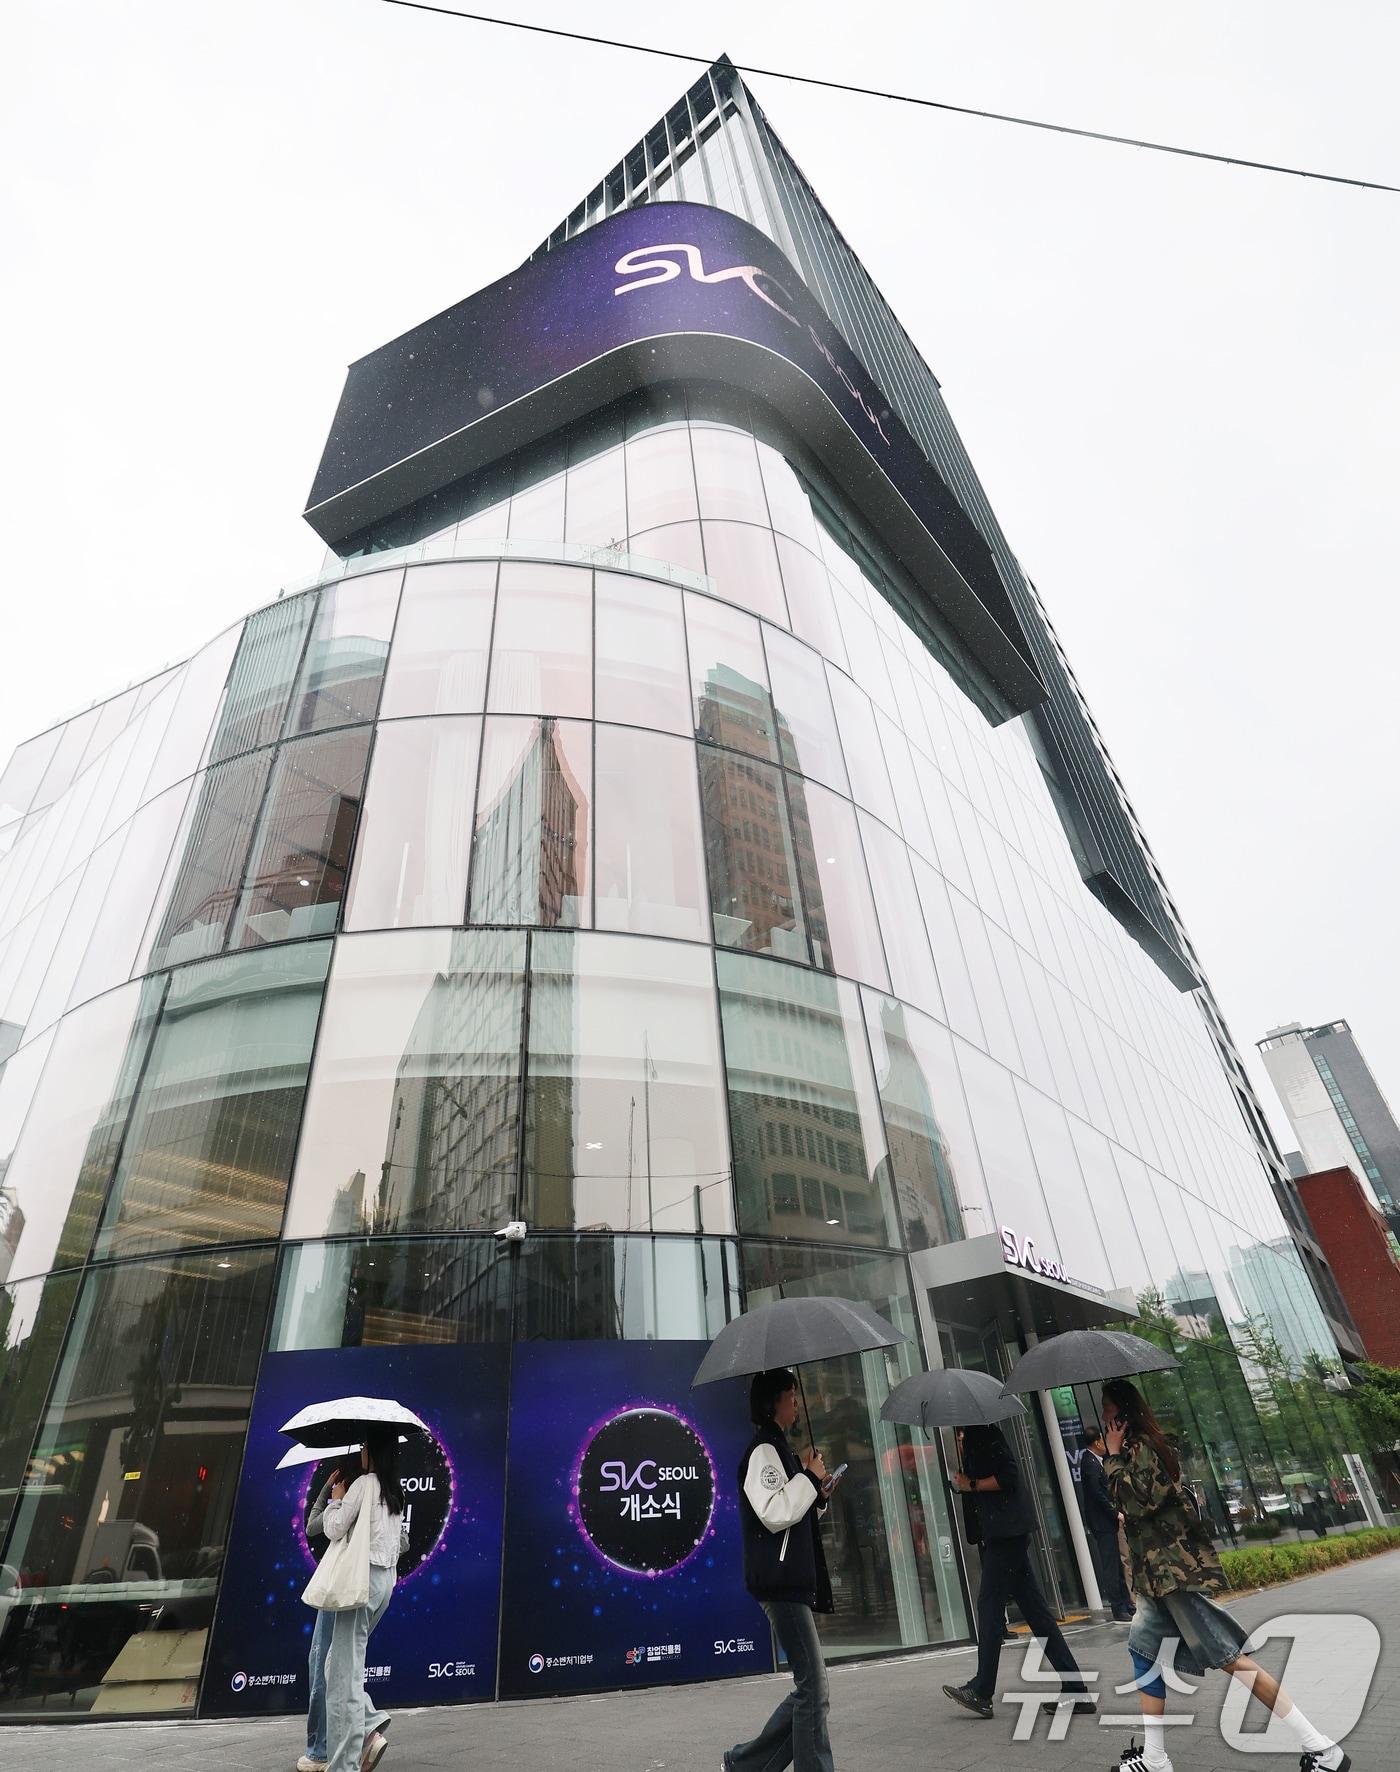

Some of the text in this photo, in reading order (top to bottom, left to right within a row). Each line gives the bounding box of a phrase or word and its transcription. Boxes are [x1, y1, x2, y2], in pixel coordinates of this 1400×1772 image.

[1040, 1256, 1072, 1284] SEOUL
[600, 1460, 699, 1491] SVC SEOUL
[400, 1477, 436, 1493] EOUL
[620, 1492, 681, 1522] 개소식
[646, 1643, 682, 1656] 창업진흥원
[713, 1639, 736, 1655] SVC
[545, 1654, 594, 1668] 중소벤처기업부
[428, 1662, 454, 1678] SVC
[454, 1667, 476, 1677] SEOUL
[248, 1673, 297, 1687] 중소벤처기업부
